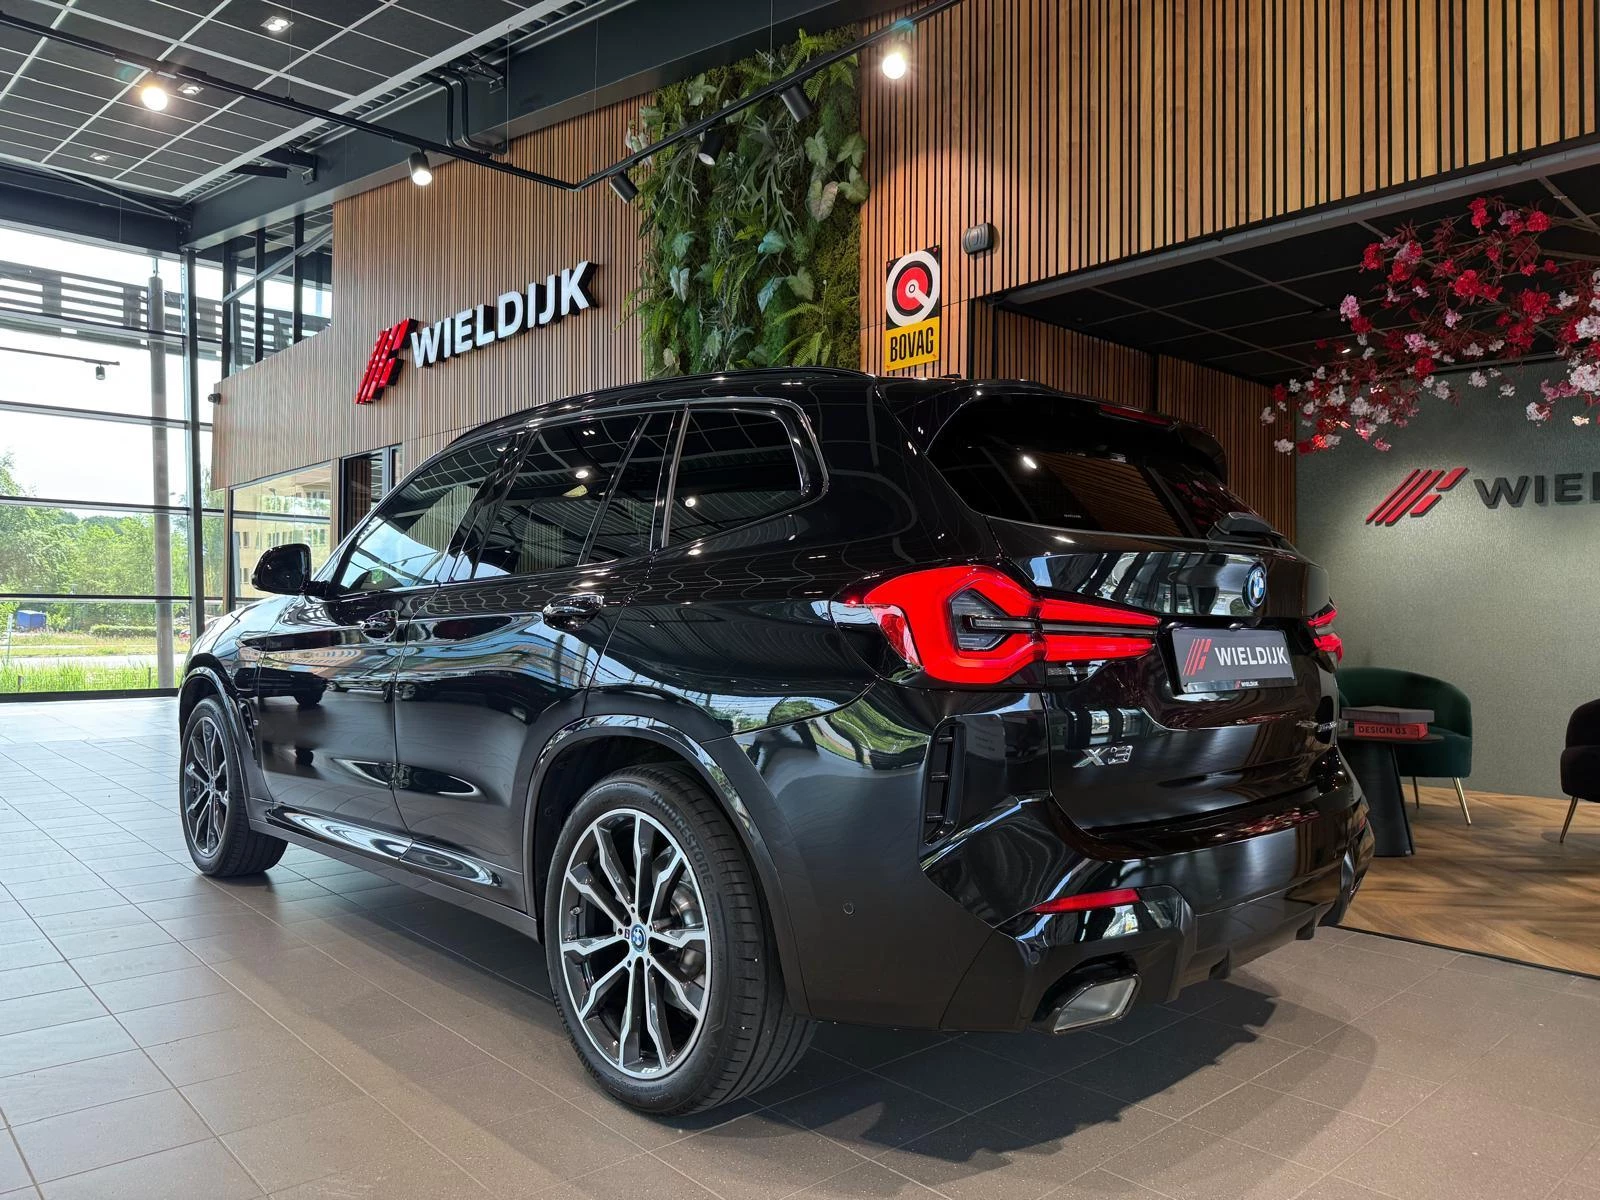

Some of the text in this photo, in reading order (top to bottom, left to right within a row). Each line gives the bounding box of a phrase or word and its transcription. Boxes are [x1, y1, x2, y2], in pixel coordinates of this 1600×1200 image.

[410, 260, 598, 369] WIELDIJK
[889, 326, 935, 363] BOVAG
[1214, 646, 1288, 666] WIELDIJK
[1358, 725, 1393, 735] DESIGN
[1072, 744, 1134, 768] X3
[649, 790, 715, 886] GESTONE
